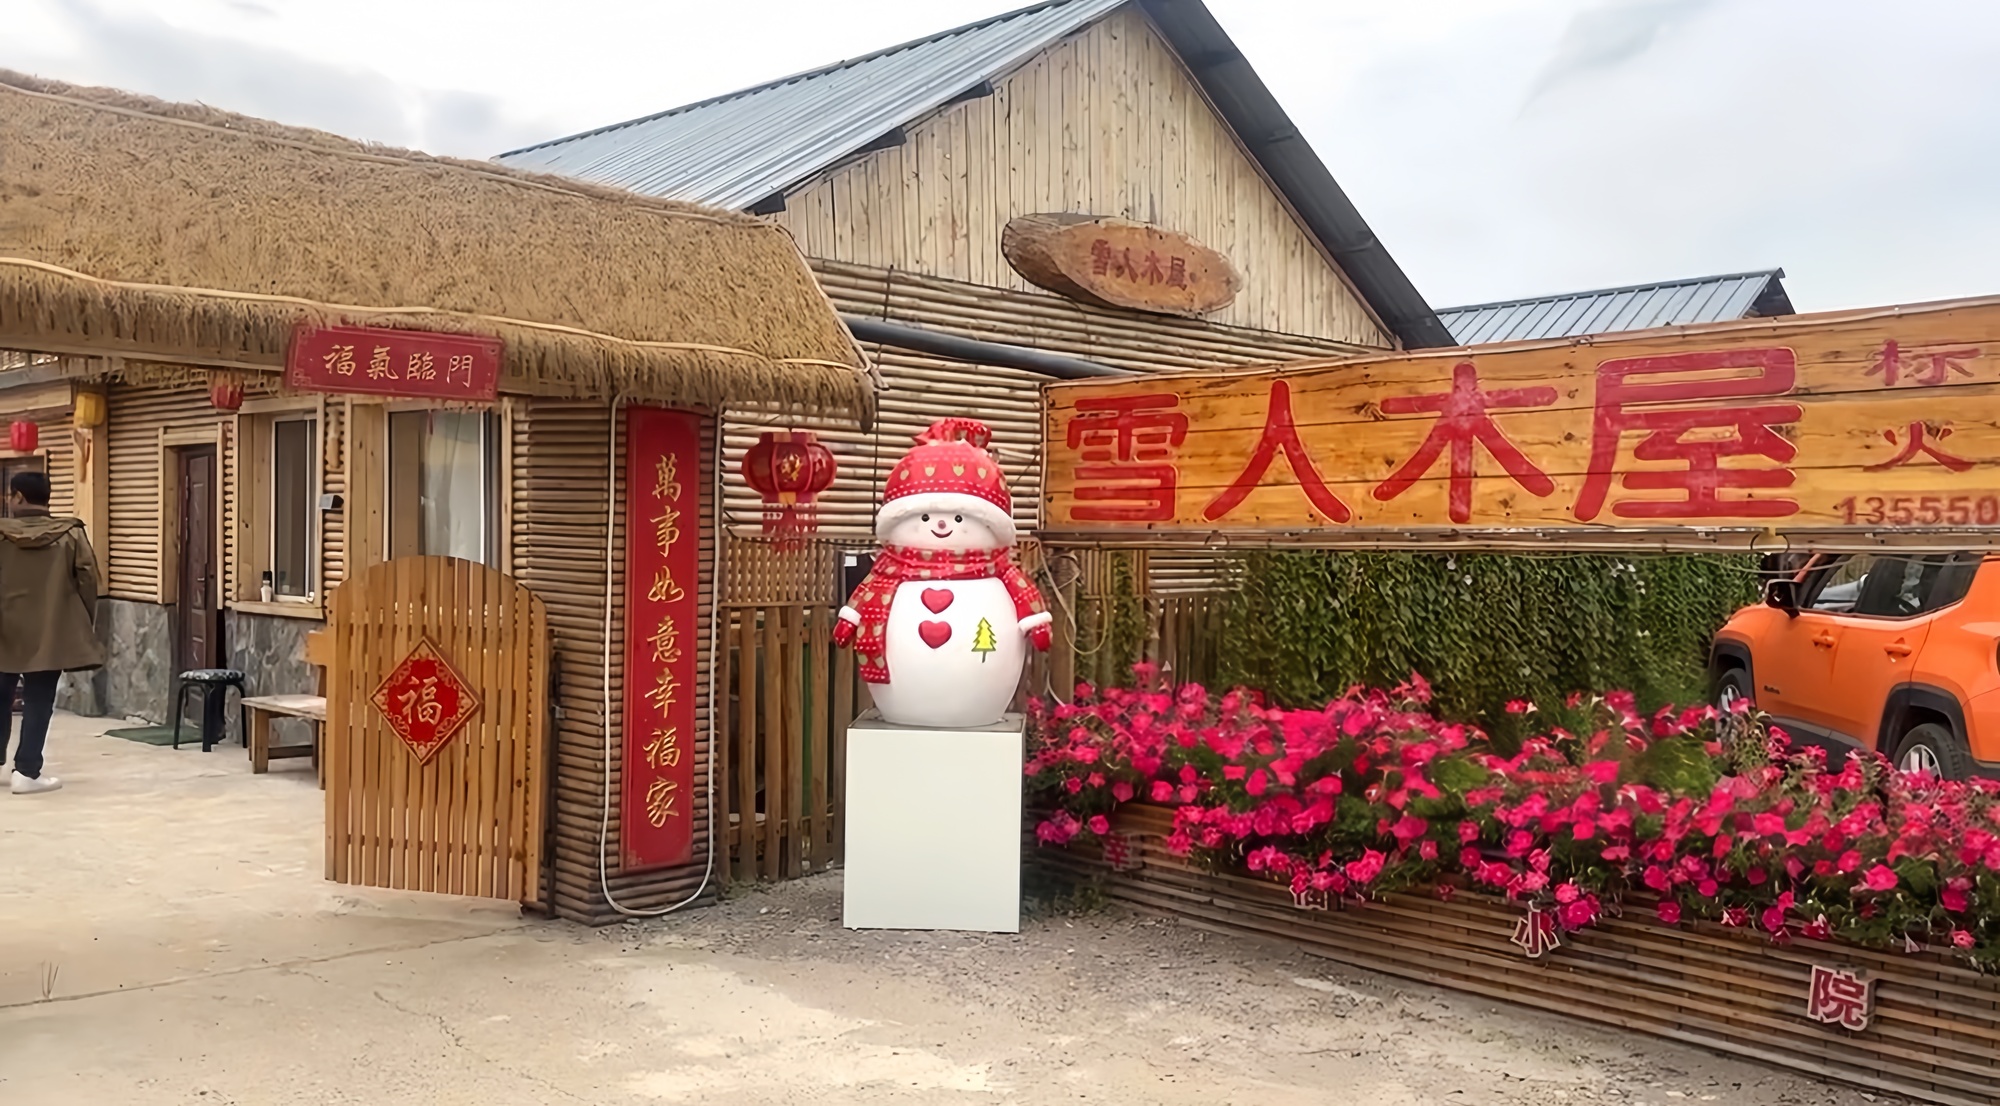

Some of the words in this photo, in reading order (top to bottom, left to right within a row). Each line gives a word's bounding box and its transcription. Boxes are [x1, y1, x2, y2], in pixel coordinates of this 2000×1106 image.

[1091, 239, 1187, 291] 雪人木屋
[323, 344, 473, 388] 福氣臨門
[1864, 338, 1982, 386] 标
[1067, 347, 1803, 523] 雪人木屋
[1863, 420, 1977, 473] 火
[643, 453, 685, 828] 萬事如意幸福家
[397, 675, 442, 725] 福
[1807, 964, 1870, 1031] 院
